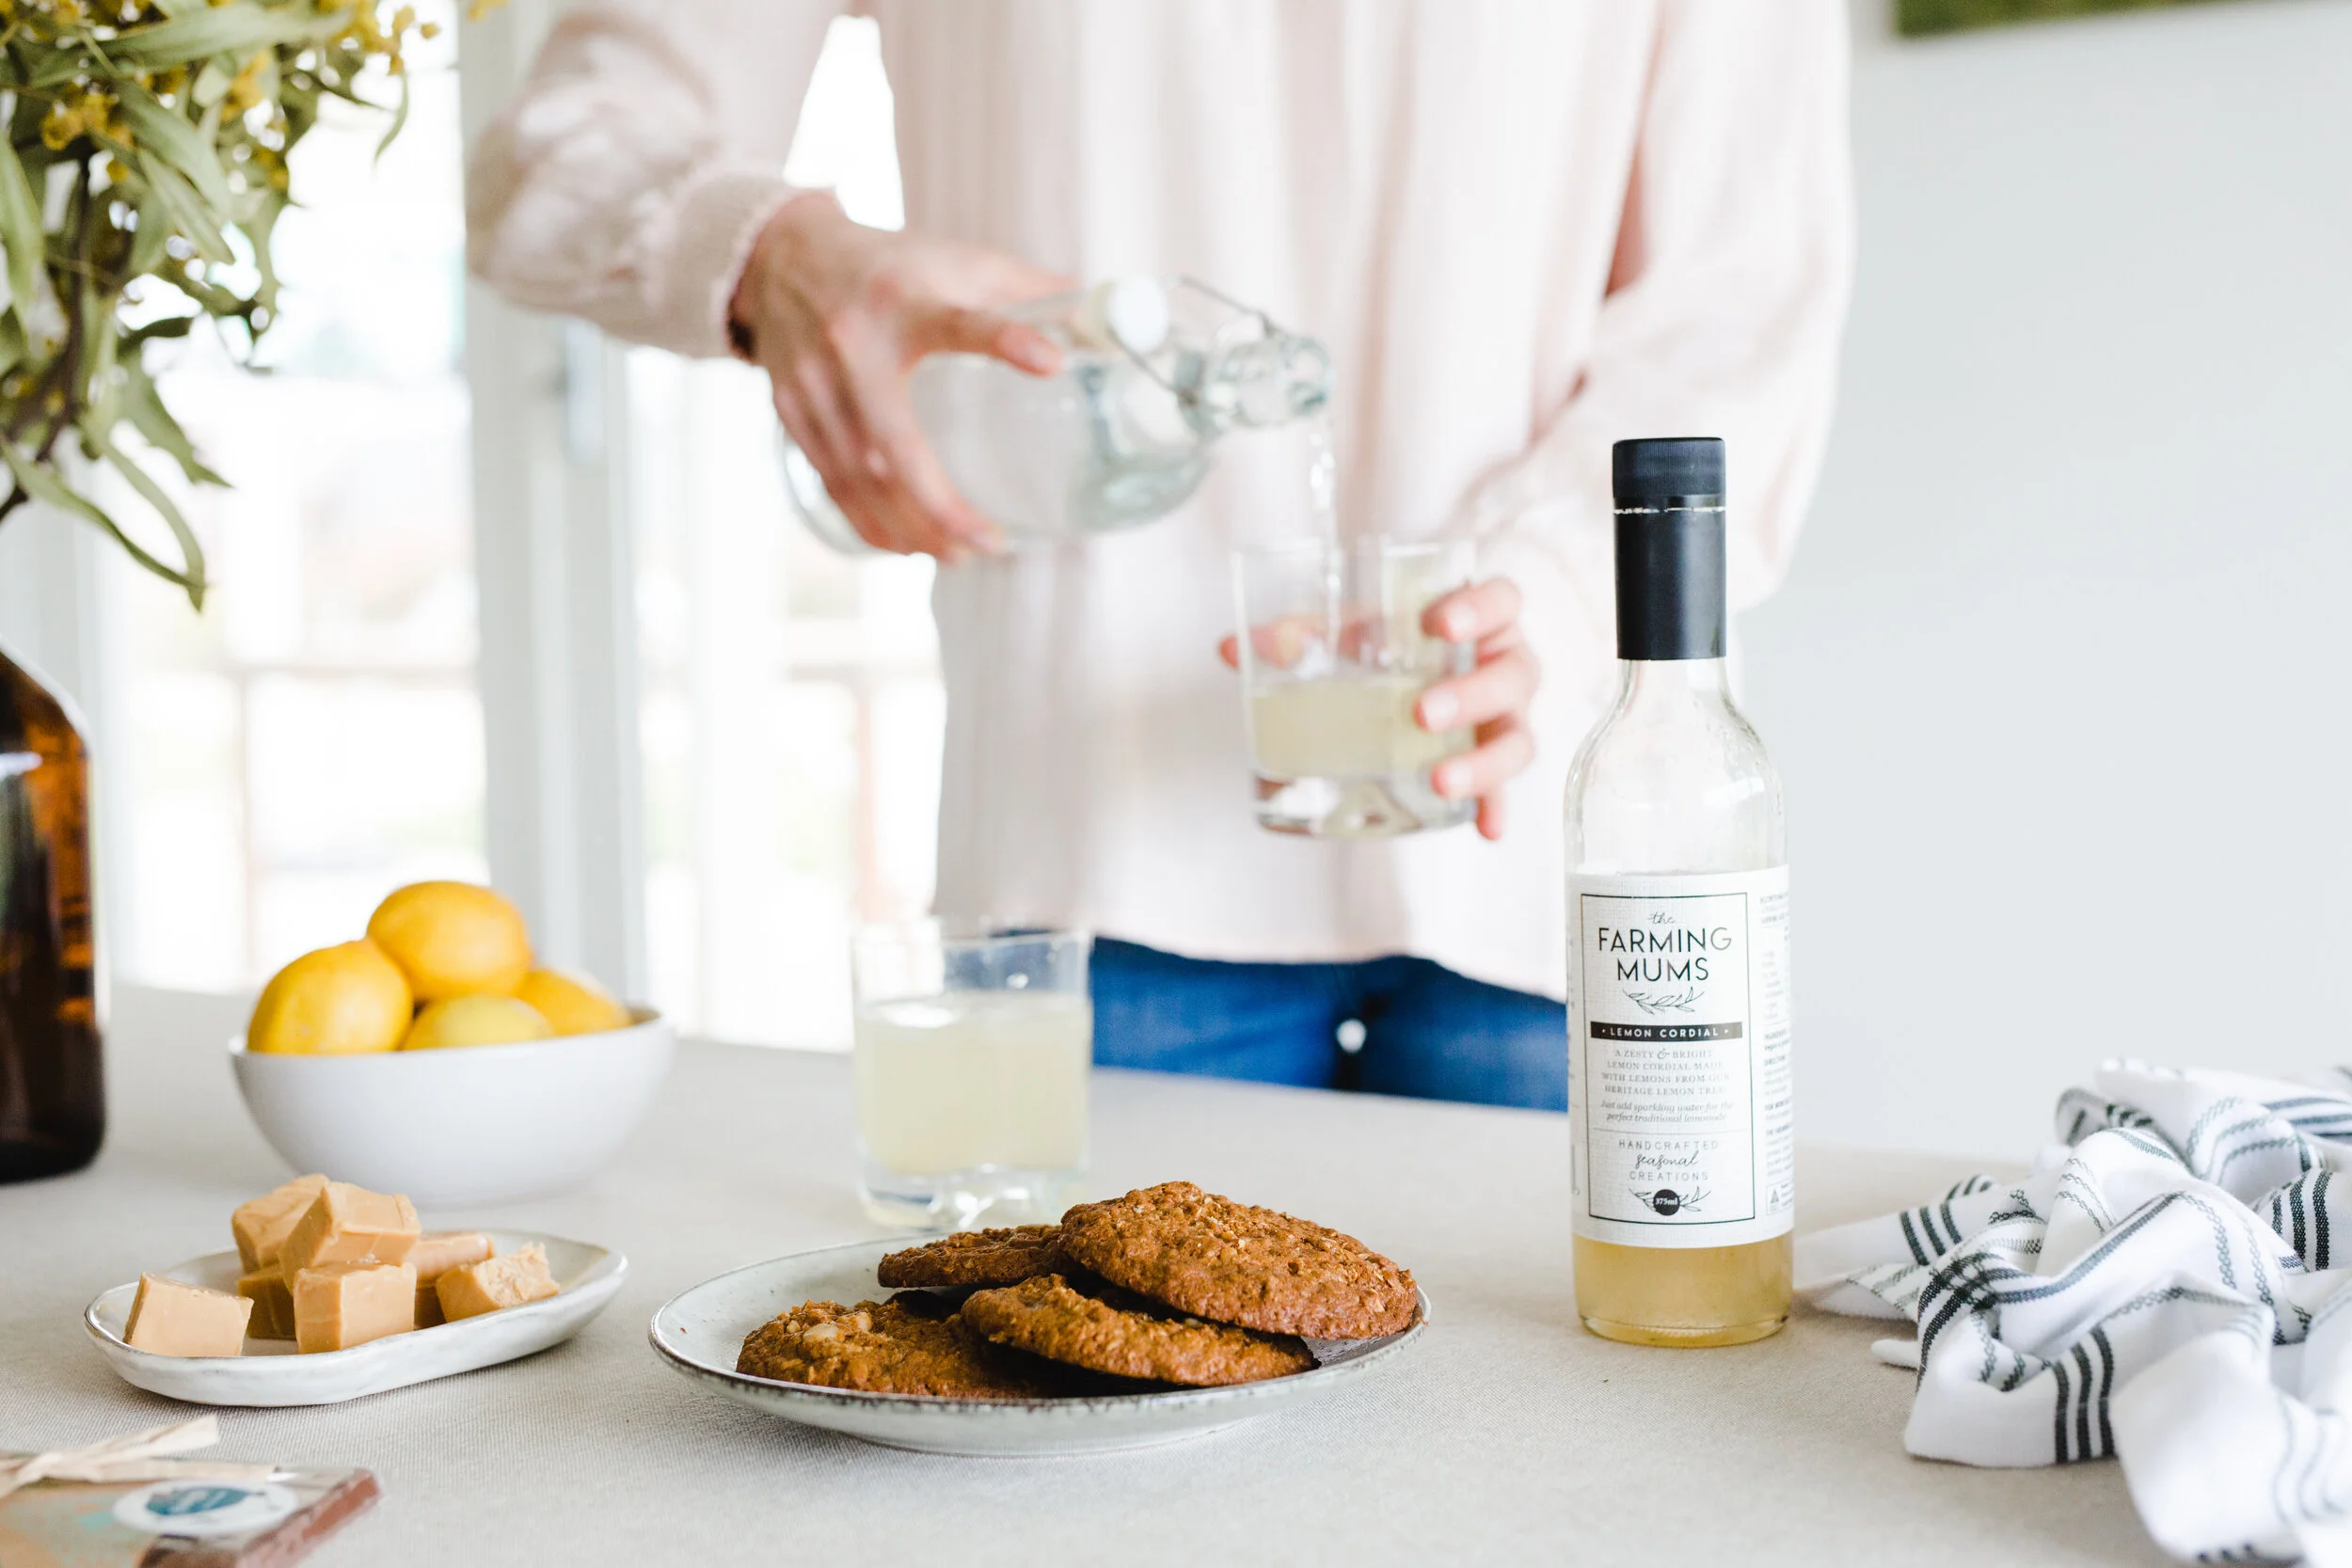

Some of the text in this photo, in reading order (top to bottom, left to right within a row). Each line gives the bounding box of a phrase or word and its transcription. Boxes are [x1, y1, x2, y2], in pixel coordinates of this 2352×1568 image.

[1647, 911, 1677, 925] the
[1598, 927, 1732, 953] FARMING
[1617, 958, 1709, 982] MUMS
[1610, 1027, 1719, 1038] LEMON CORDIAL
[1624, 1050, 1654, 1058] ZESTY
[1657, 1048, 1670, 1060] &
[1673, 1050, 1713, 1058] BRIGHT
[1607, 1061, 1640, 1069] LEMON
[1643, 1062, 1691, 1071] CORDIAL
[1601, 1072, 1626, 1082] WITH
[1629, 1074, 1671, 1083] LEMONS
[1675, 1074, 1706, 1083] FROM
[1604, 1085, 1654, 1095] HERITAGE
[1657, 1087, 1694, 1096] LEMON
[1600, 1100, 1615, 1110] Just
[1616, 1101, 1631, 1111] add
[1633, 1101, 1676, 1113] sparkling
[1677, 1102, 1703, 1111] water
[1606, 1112, 1633, 1123] perfect
[1635, 1113, 1682, 1123] traditional
[1619, 1139, 1719, 1150] HANDCRAFTED
[1635, 1149, 1699, 1170] seasonal
[1629, 1171, 1708, 1181] CREATIONS
[1655, 1196, 1679, 1207] 375ml
